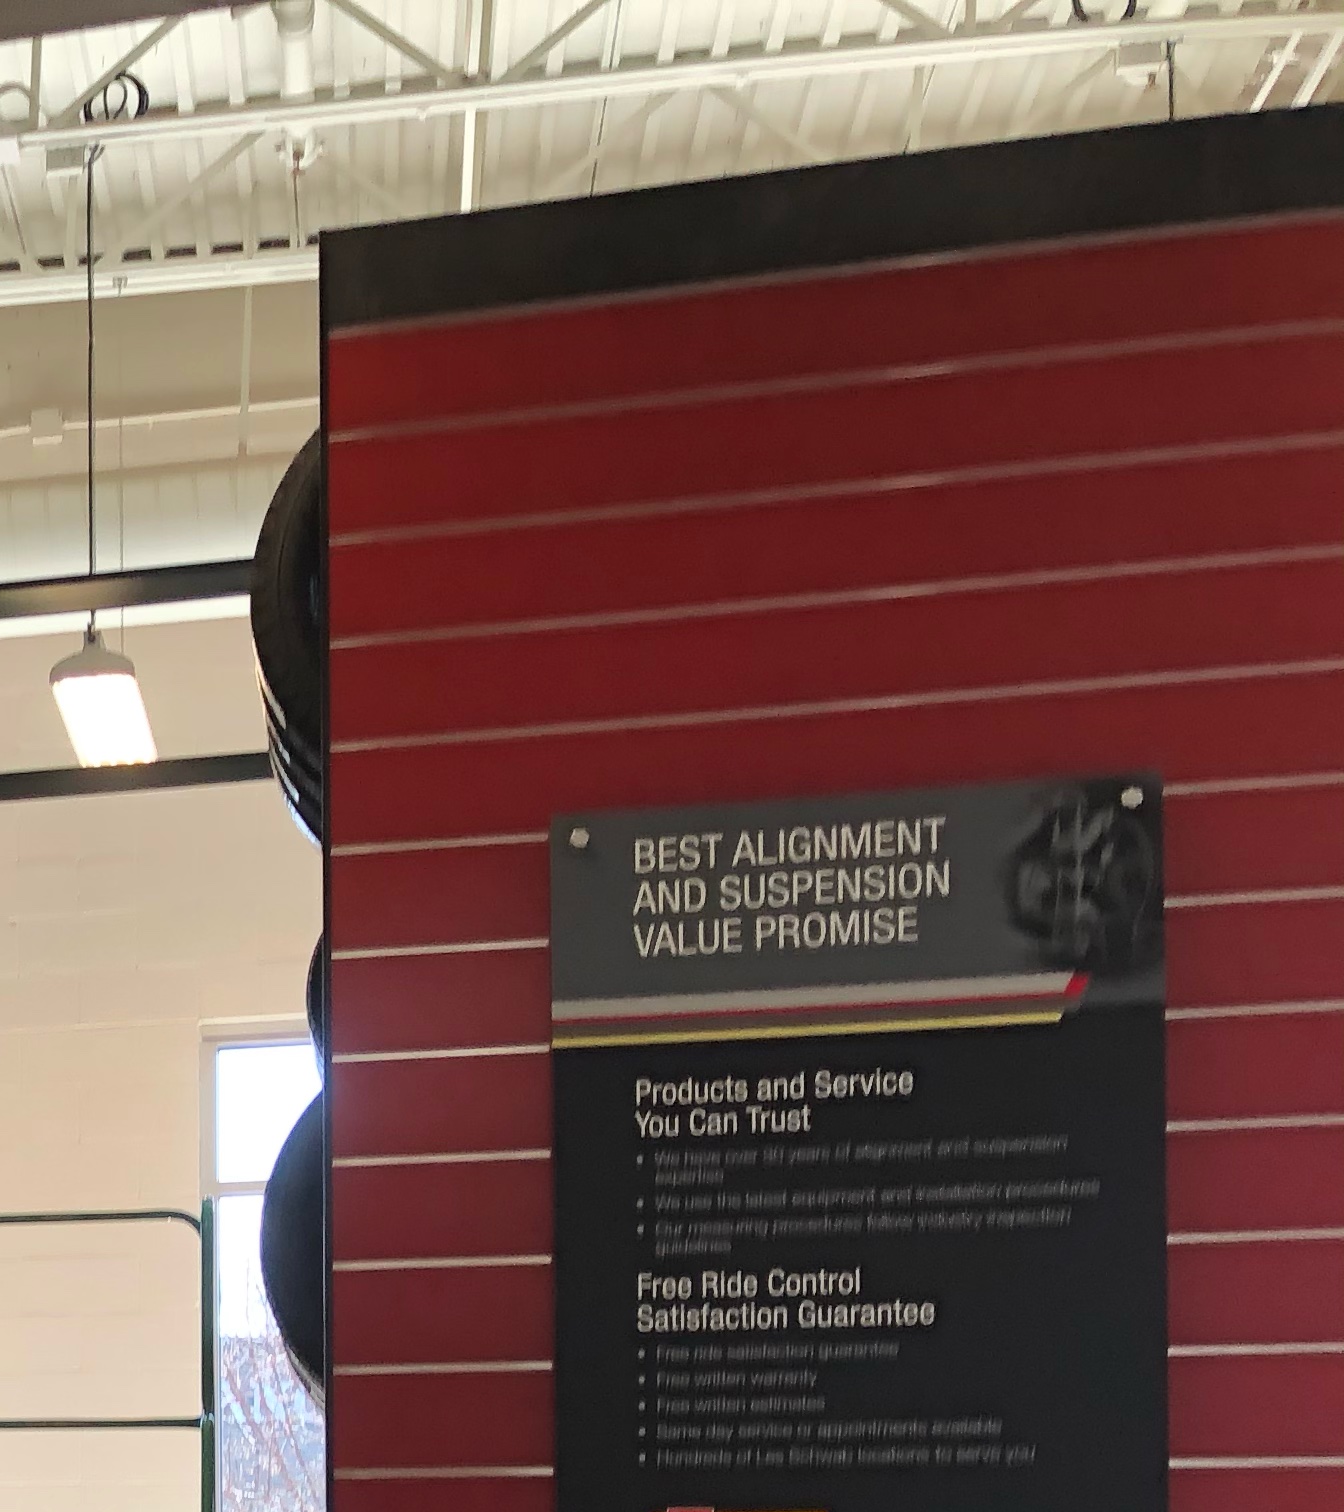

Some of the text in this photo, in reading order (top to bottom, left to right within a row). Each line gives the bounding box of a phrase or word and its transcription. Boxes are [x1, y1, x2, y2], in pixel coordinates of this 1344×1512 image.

[633, 816, 947, 875] BEST ALIGNMENT
[632, 860, 951, 916] AND SUSPENSION
[633, 906, 919, 958] VALUE PROMISE
[636, 1068, 914, 1106] Products and Service
[635, 1103, 811, 1138] You Can Trust
[637, 1266, 861, 1301] Free Ride Control
[637, 1299, 936, 1334] Satisfaction Guarantee
